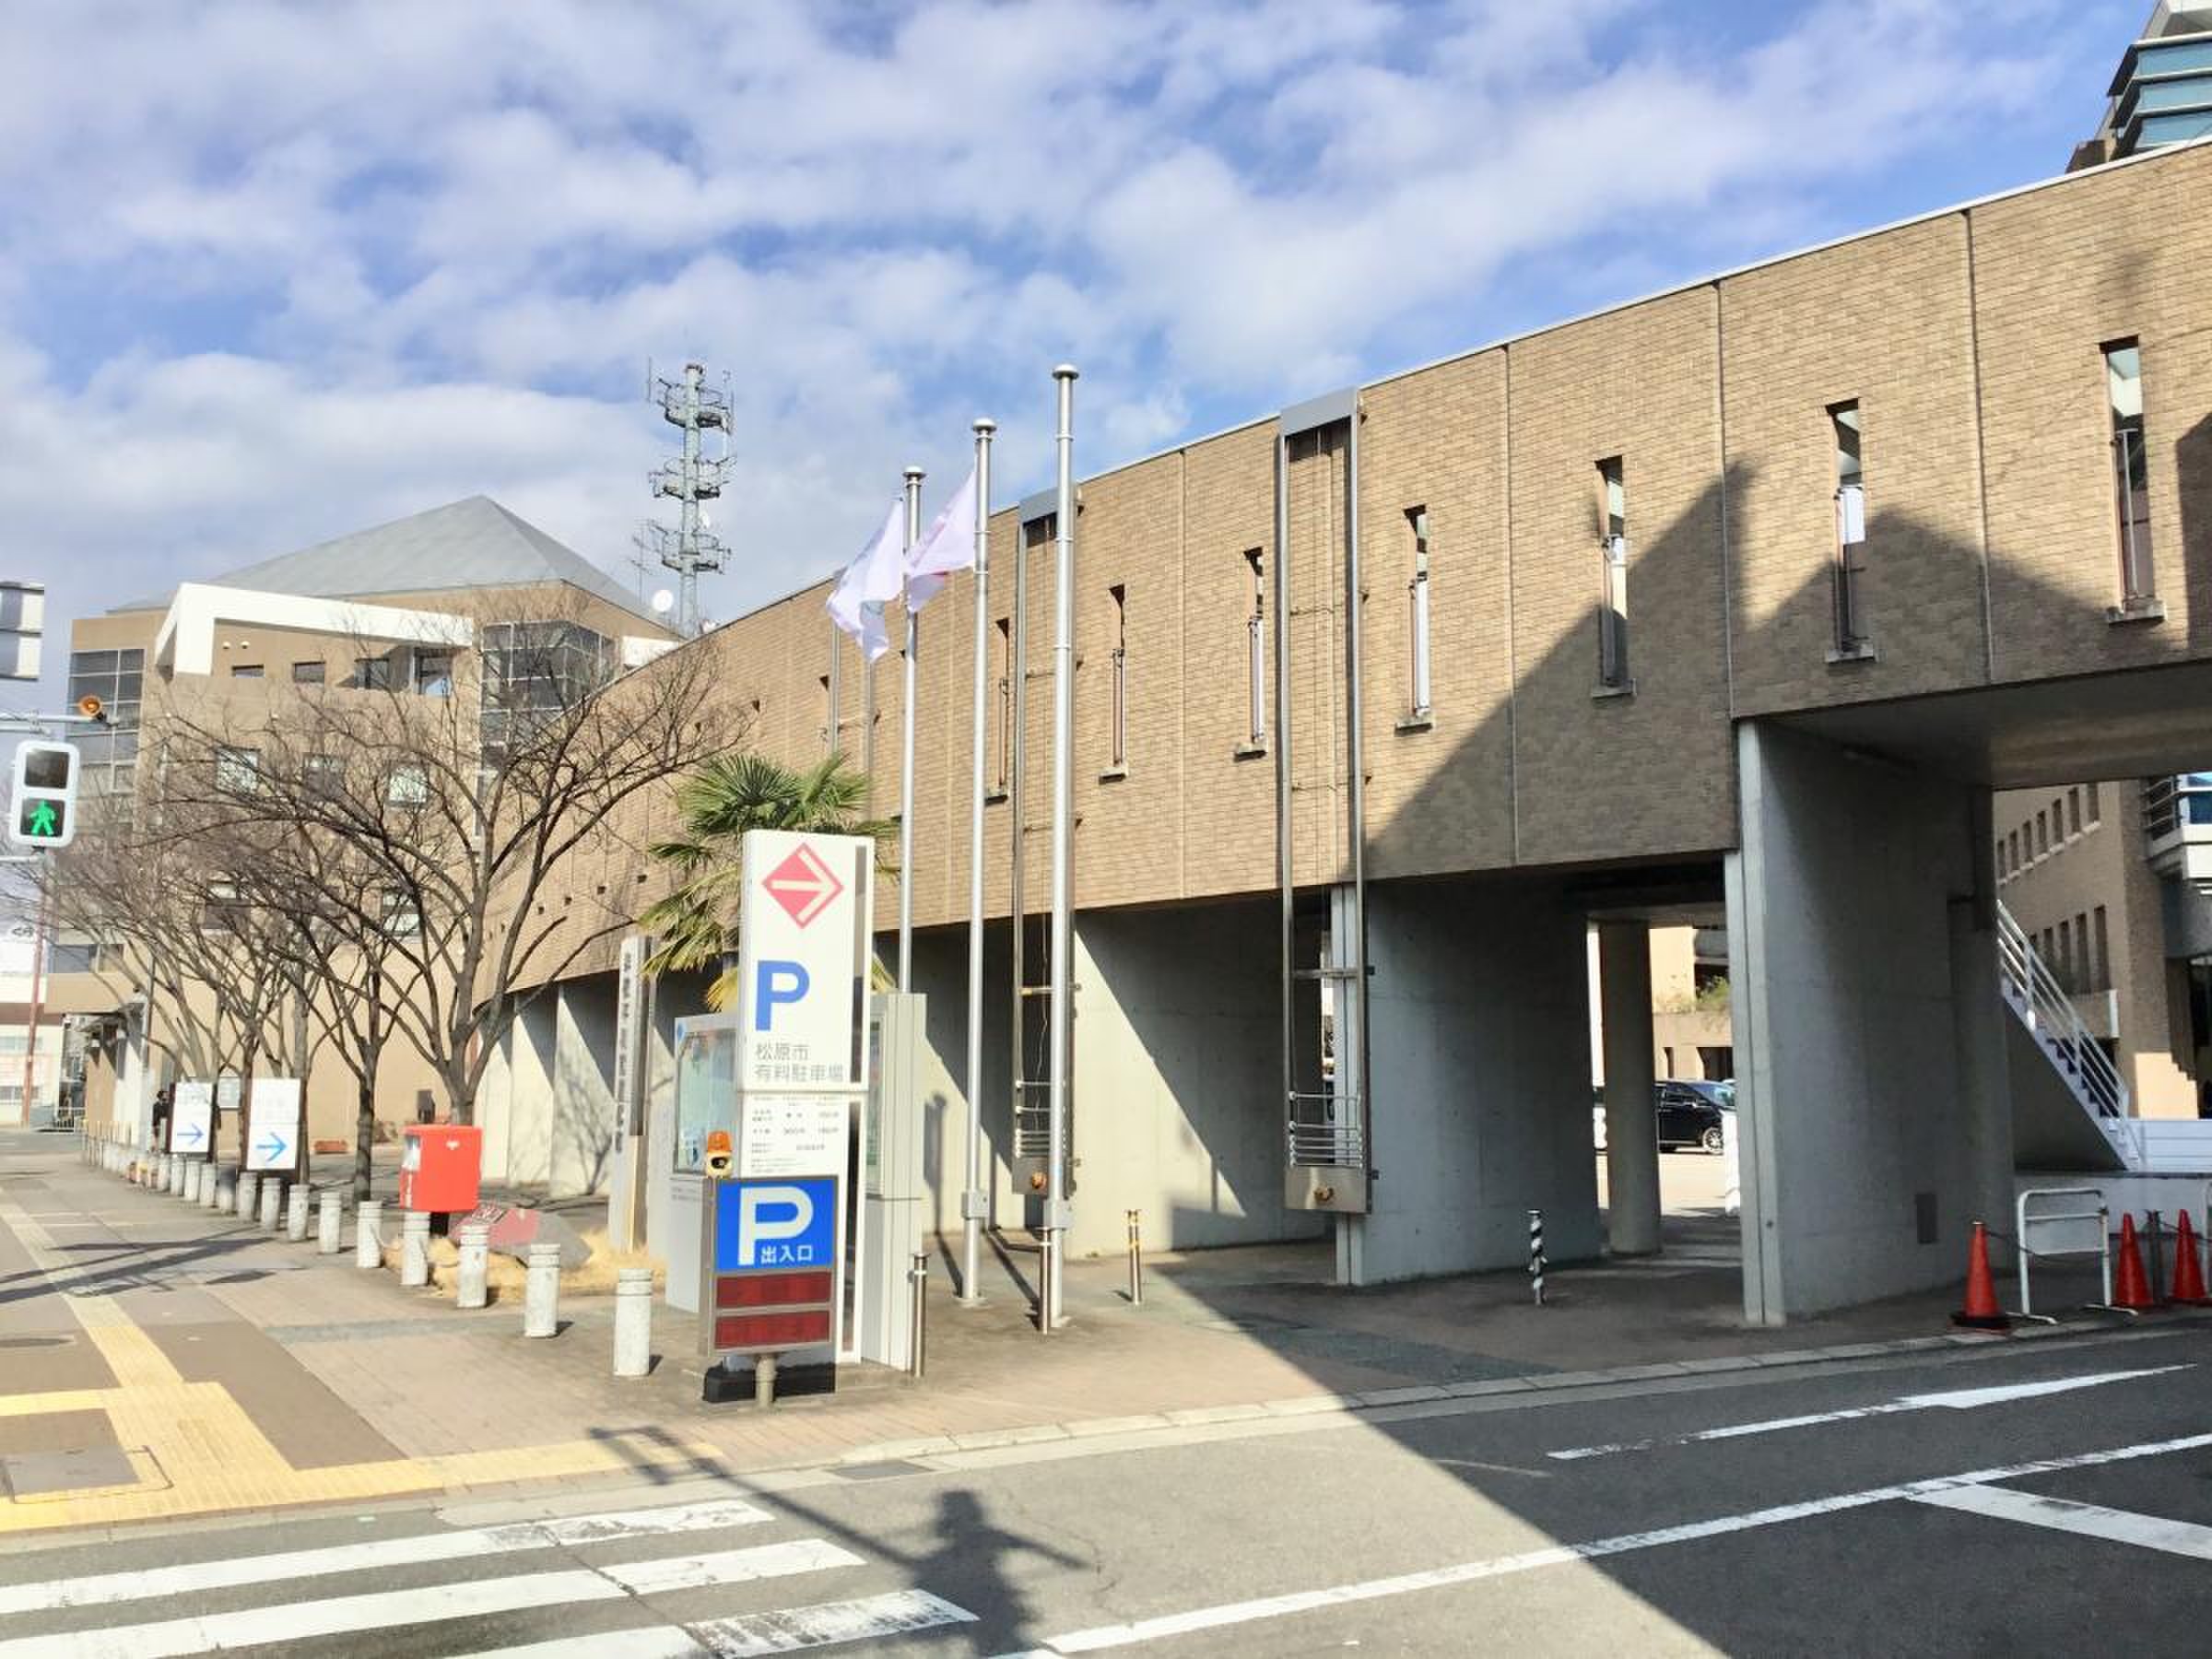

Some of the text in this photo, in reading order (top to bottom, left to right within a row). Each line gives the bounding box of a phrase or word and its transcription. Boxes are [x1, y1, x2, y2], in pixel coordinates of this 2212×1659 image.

[756, 959, 810, 1031] P
[755, 1041, 811, 1062] 松原市
[755, 1063, 844, 1083] 有料駐車場
[738, 1186, 814, 1265] P
[760, 1245, 813, 1265] 出入口
